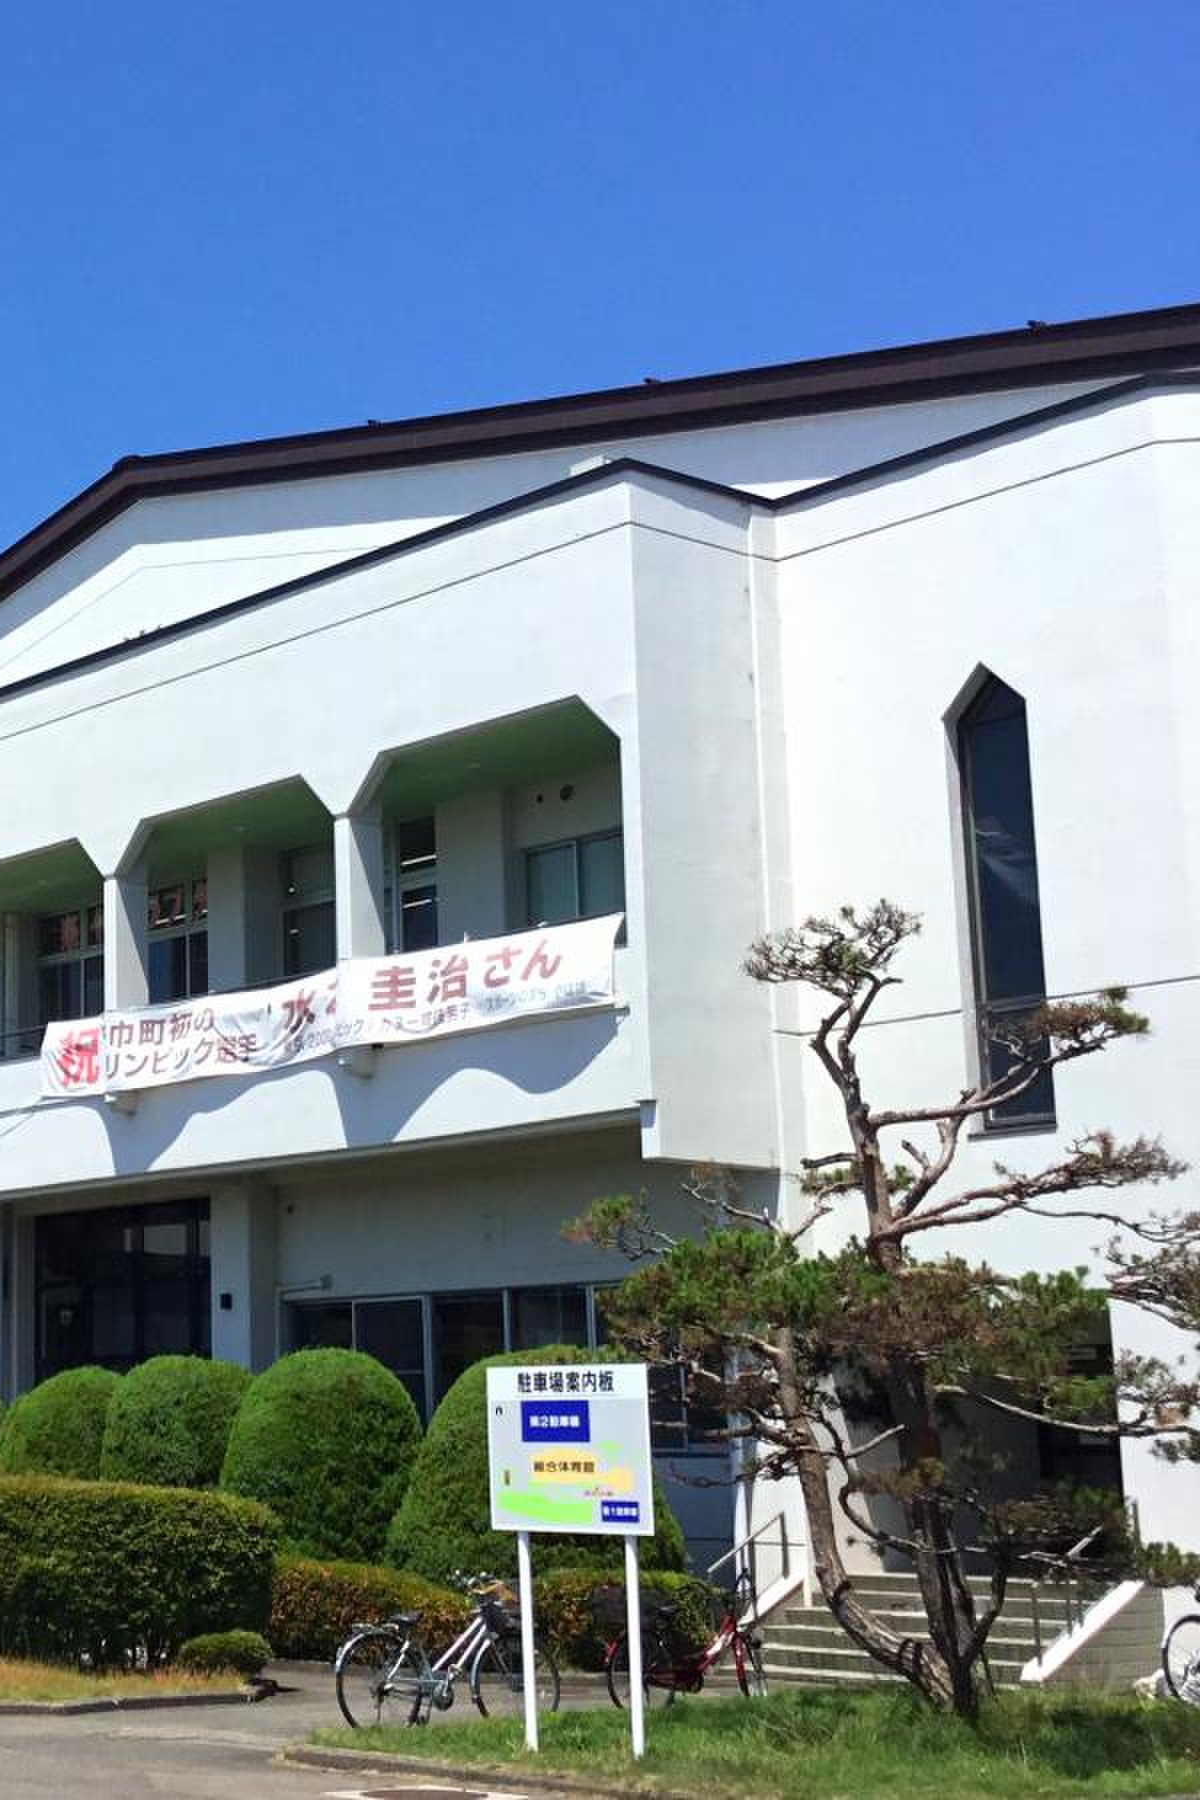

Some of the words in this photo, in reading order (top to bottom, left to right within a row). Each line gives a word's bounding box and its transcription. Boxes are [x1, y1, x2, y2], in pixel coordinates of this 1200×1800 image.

[282, 939, 563, 1034] 水圭治さん
[102, 1008, 214, 1048] 巾町初の
[59, 1027, 101, 1087] 祝
[105, 1033, 257, 1080] リンピック選手
[517, 1370, 614, 1392] 駐車場案内板
